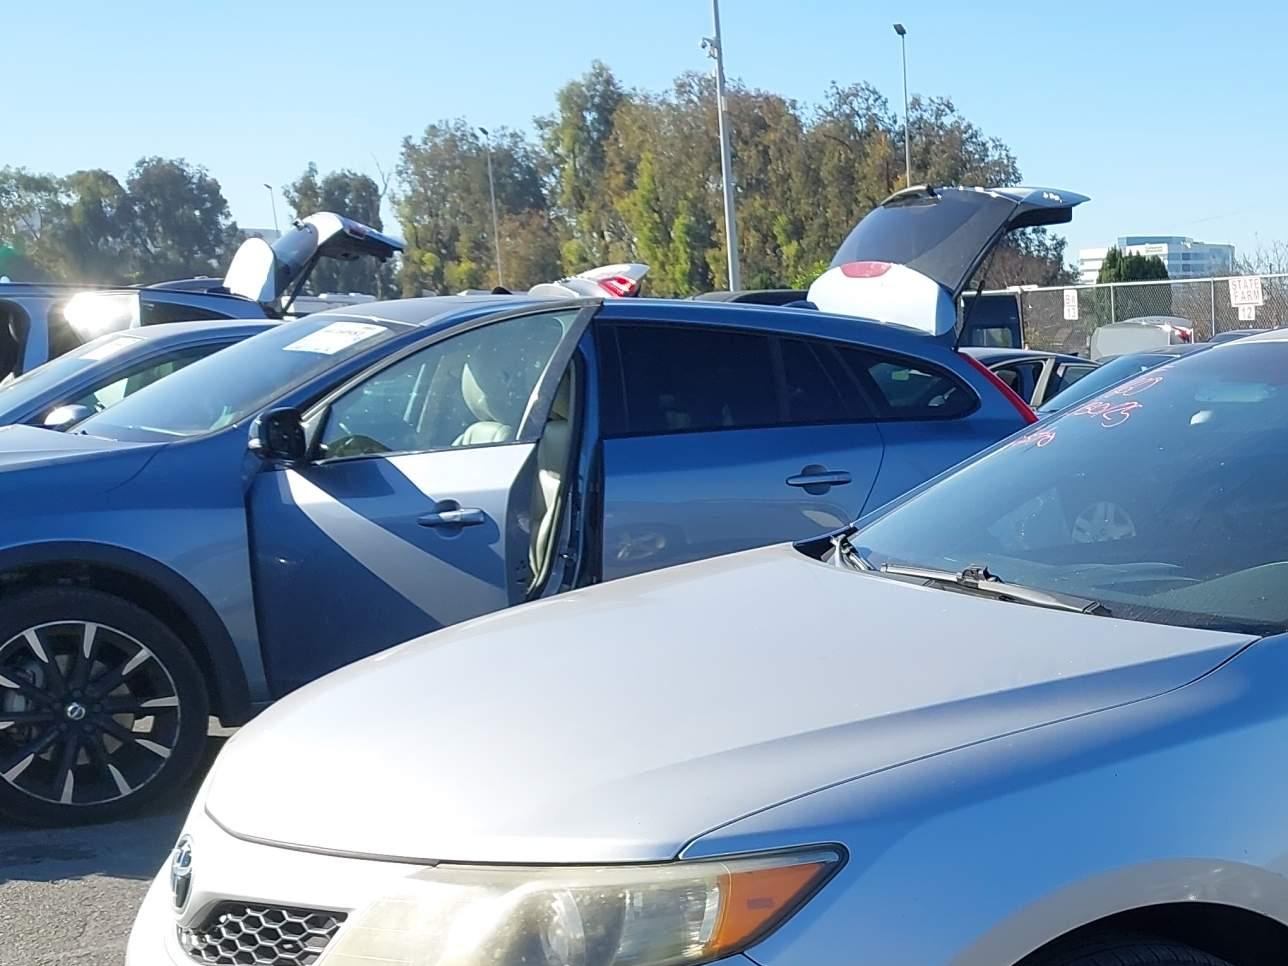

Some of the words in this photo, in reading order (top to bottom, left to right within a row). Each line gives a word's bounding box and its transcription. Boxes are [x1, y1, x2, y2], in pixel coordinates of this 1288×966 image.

[1231, 278, 1260, 291] STATE
[1234, 289, 1260, 302] FARM
[1242, 306, 1253, 319] 12
